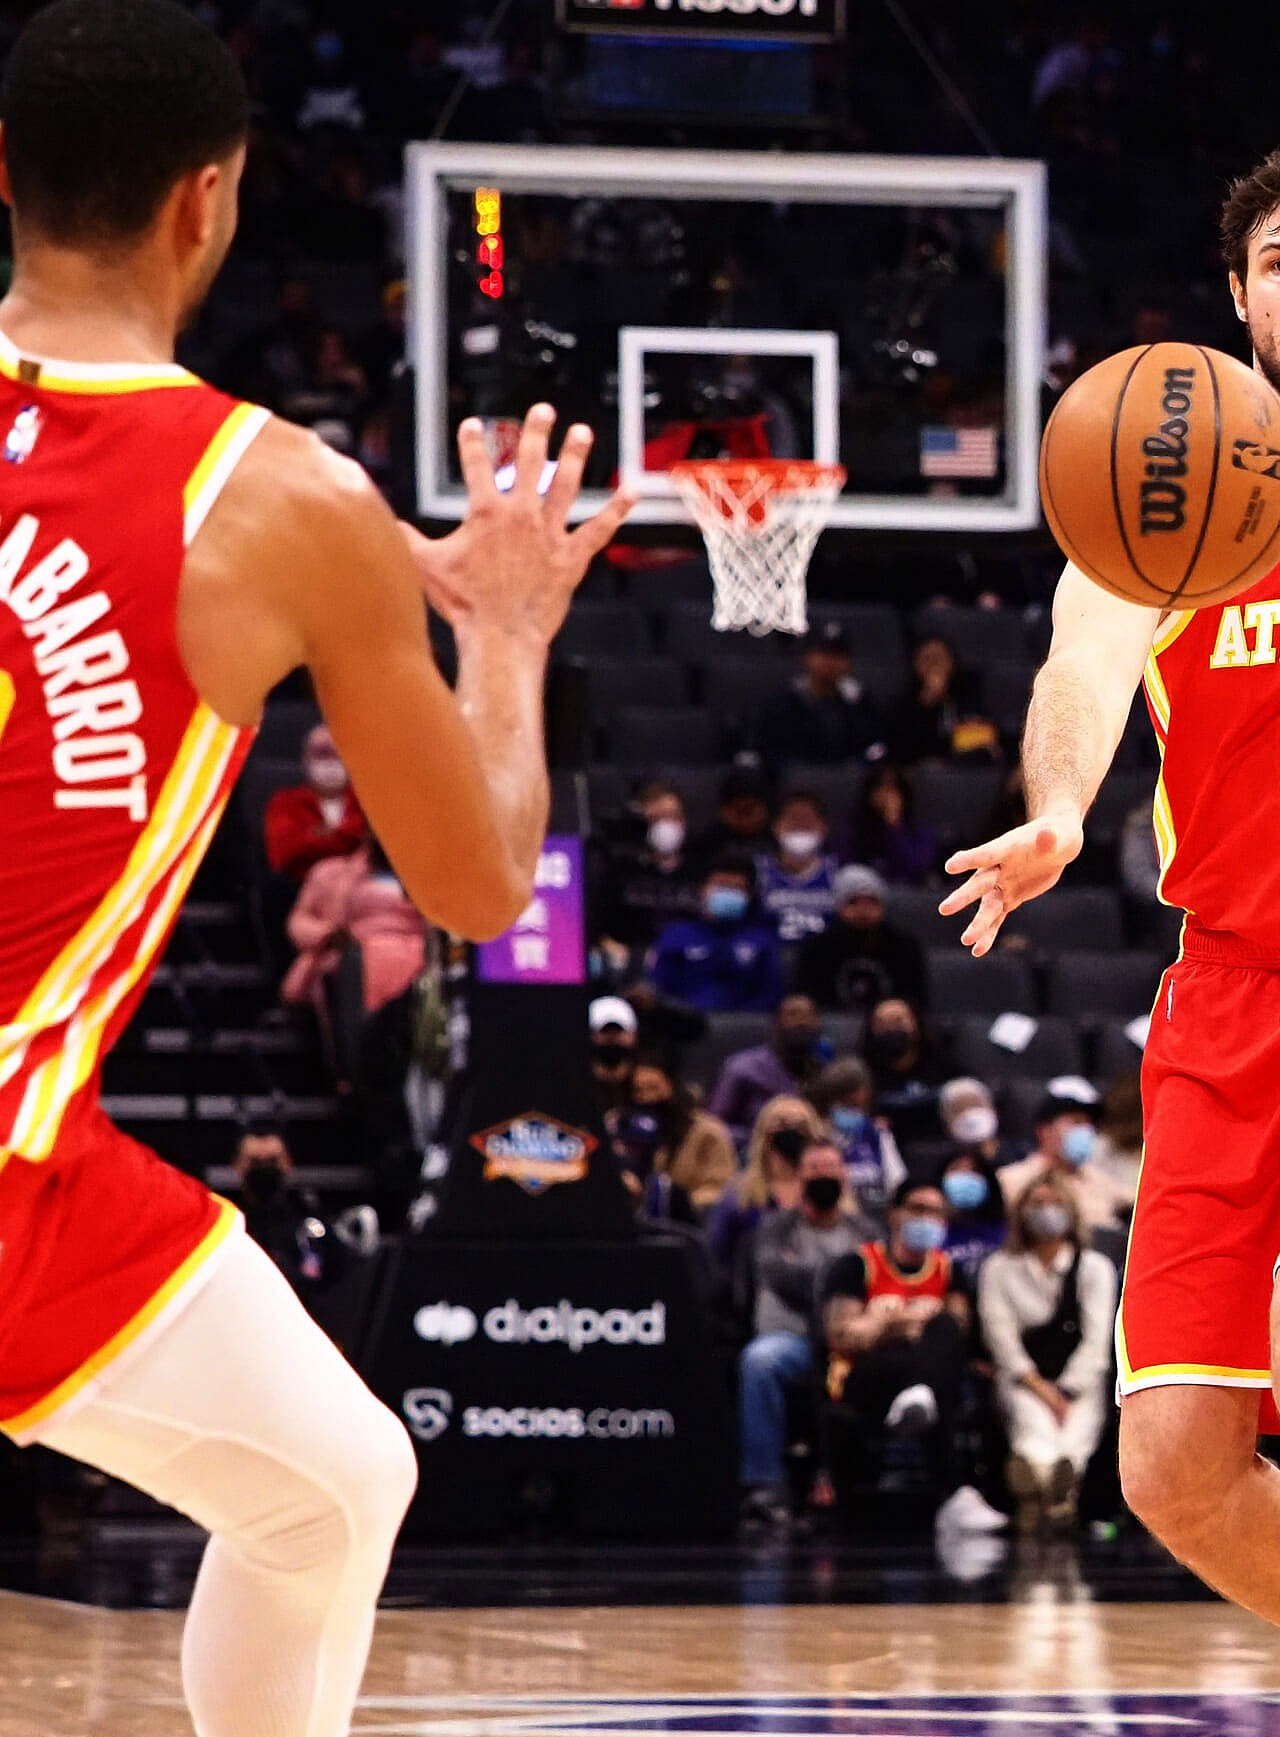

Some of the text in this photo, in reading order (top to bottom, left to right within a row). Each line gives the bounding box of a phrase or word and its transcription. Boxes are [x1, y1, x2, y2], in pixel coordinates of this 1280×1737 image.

[1139, 367, 1196, 537] Wilson
[482, 1298, 667, 1352] dialpad
[462, 1406, 676, 1438] socios.com
